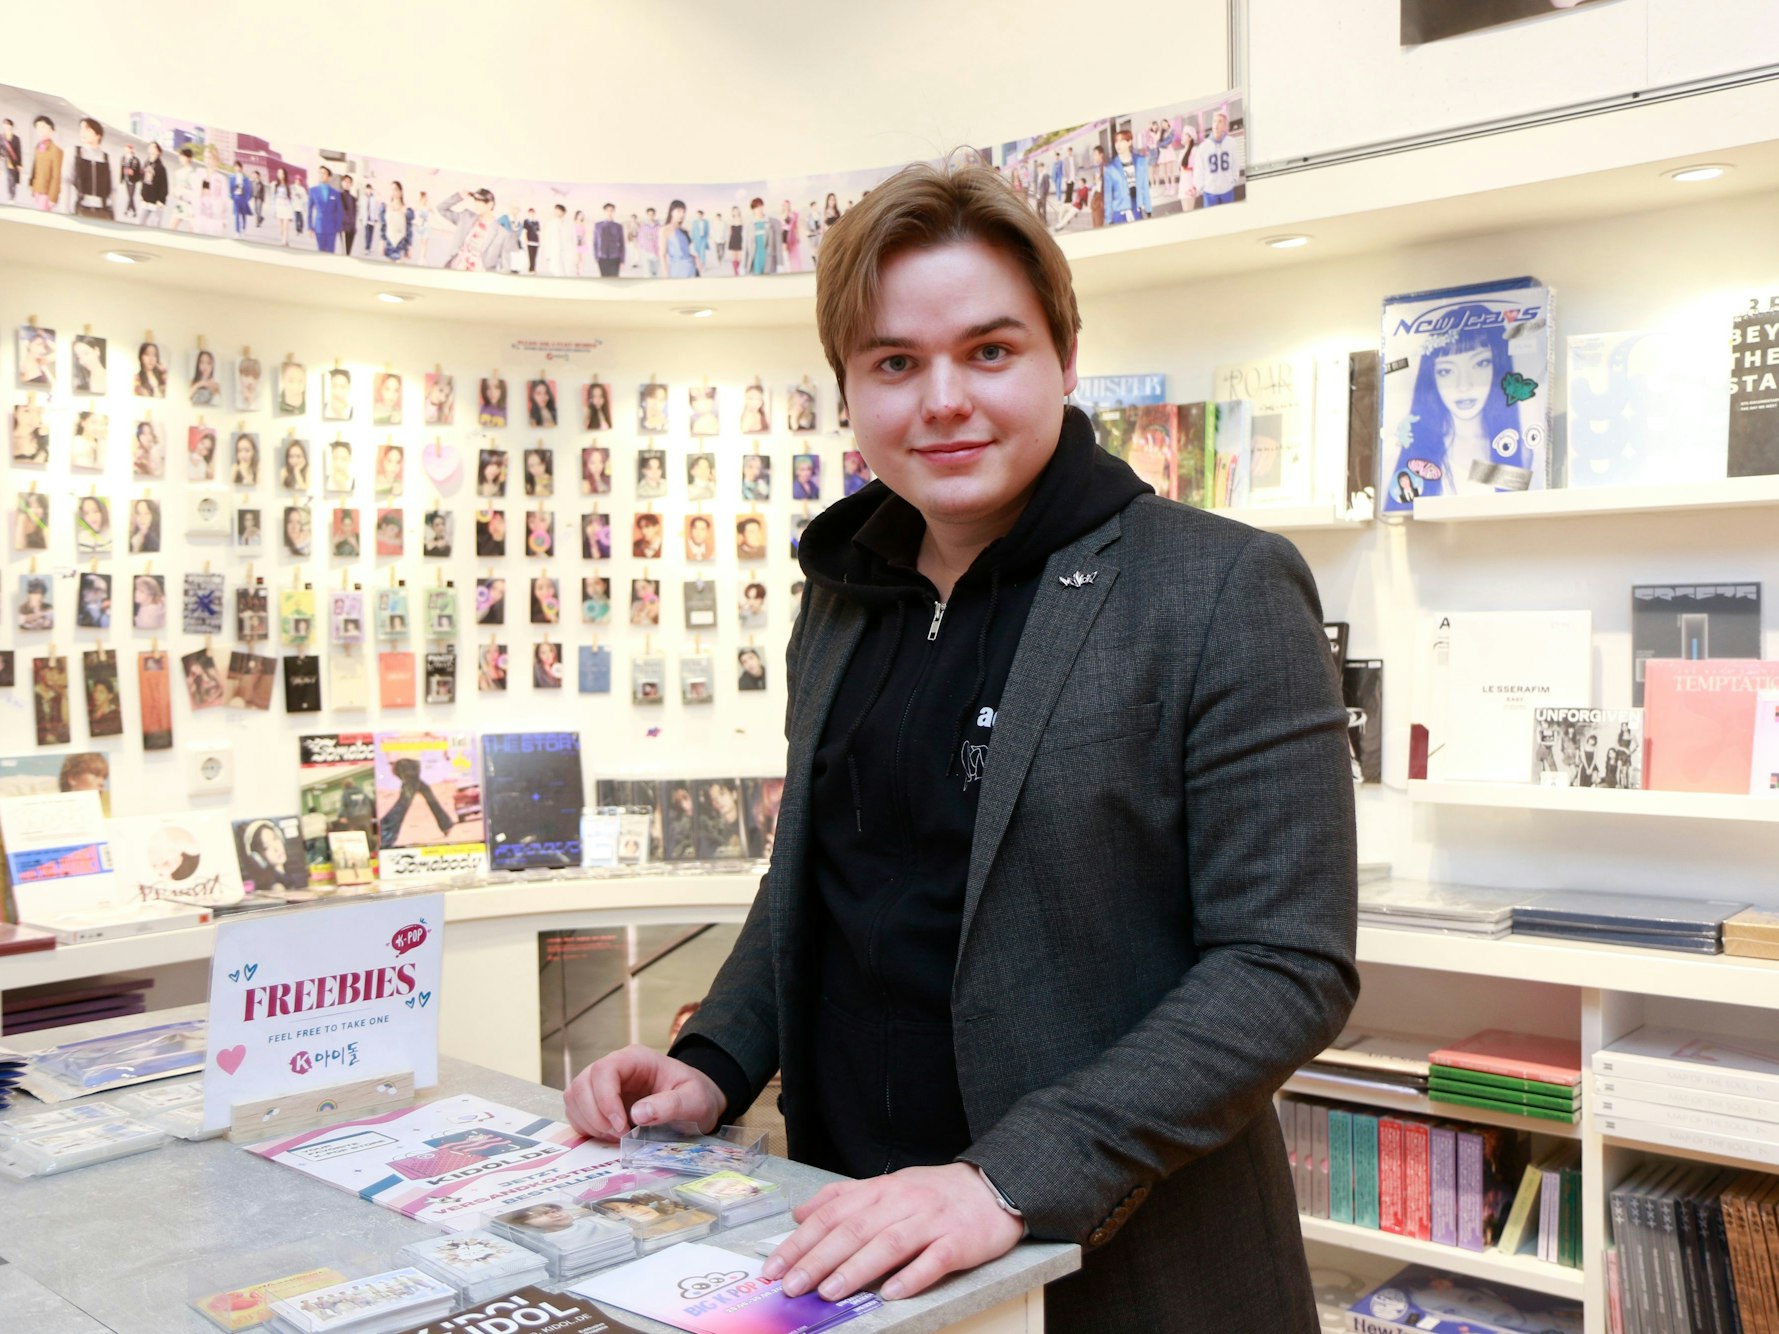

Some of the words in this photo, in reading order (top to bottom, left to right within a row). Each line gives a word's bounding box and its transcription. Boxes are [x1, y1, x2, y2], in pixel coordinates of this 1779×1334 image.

[1209, 152, 1230, 173] 96
[1731, 347, 1779, 370] THE
[1496, 685, 1550, 693] SSERAFIM
[977, 706, 998, 727] a
[1535, 709, 1642, 726] UNFORGIVEN
[395, 928, 424, 947] K-POP
[243, 962, 416, 1022] FREEBIES
[268, 1032, 293, 1044] FEEL
[296, 1027, 322, 1039] FREE
[325, 1024, 338, 1033] TO
[342, 1019, 366, 1030] TAKE
[369, 1014, 390, 1025] ONE
[314, 1042, 360, 1068] 아이돌
[497, 1167, 560, 1188] JETZT
[502, 1170, 612, 1205] BESTELLEN
[683, 1299, 718, 1317] BIG
[726, 1281, 756, 1298] POP
[442, 1302, 581, 1334] IDOL
[541, 1313, 593, 1333] KIDOL.DE
